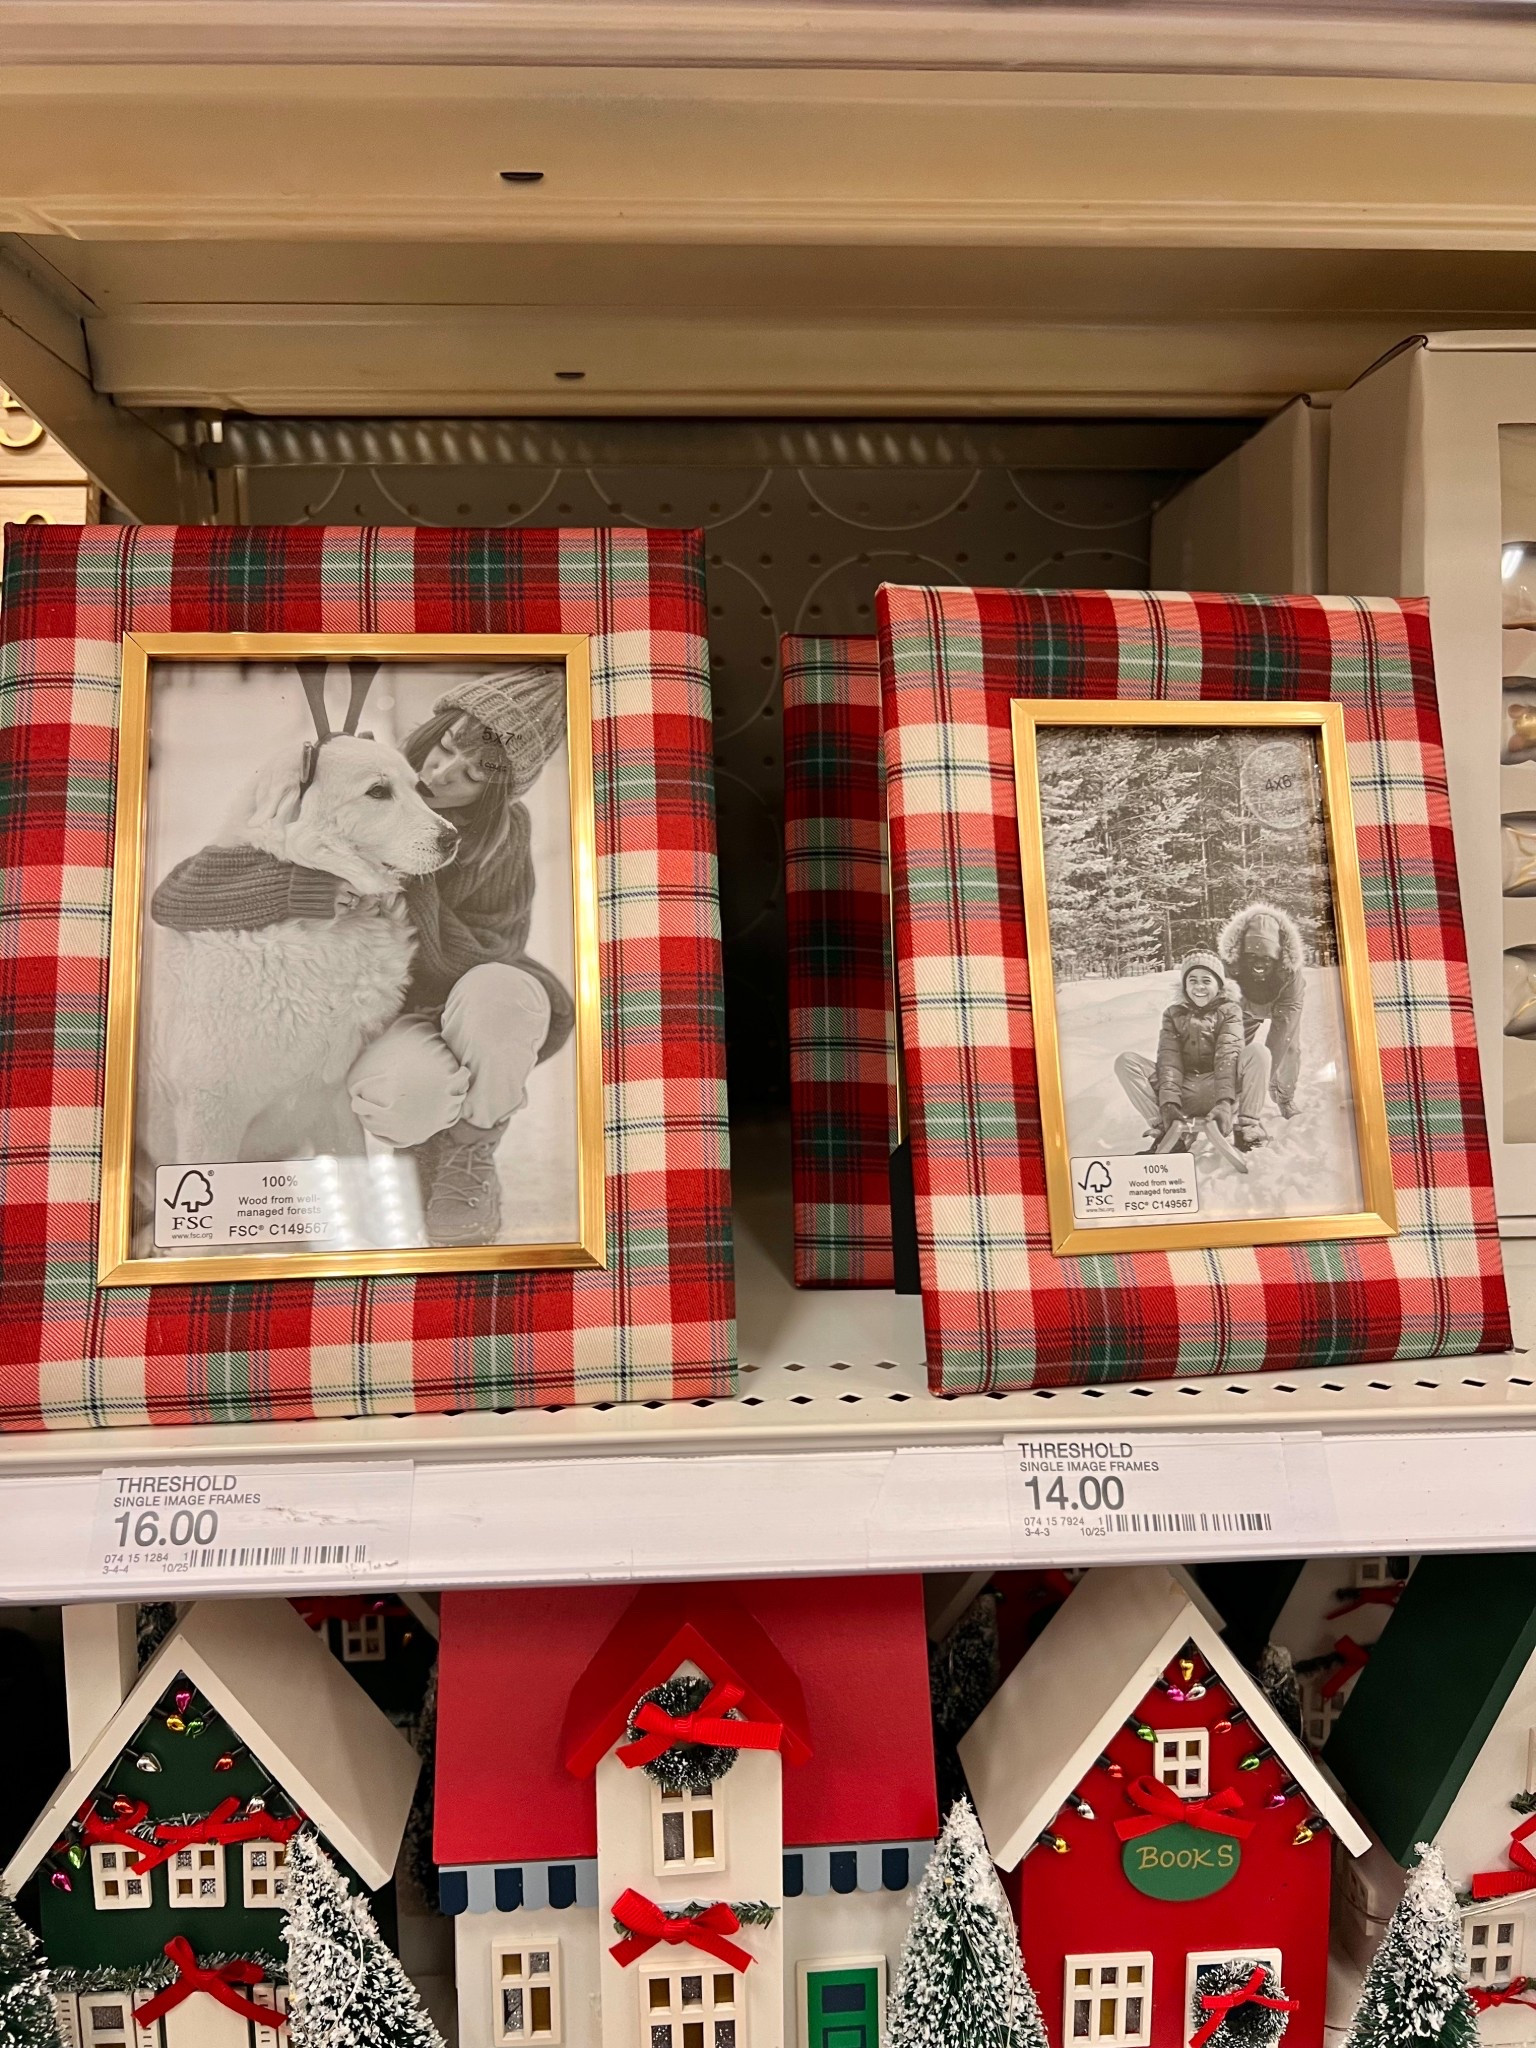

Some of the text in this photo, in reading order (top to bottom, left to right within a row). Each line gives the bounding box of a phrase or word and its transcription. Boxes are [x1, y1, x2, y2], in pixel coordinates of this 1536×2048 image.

[1143, 1164, 1169, 1174] 100%
[261, 1175, 298, 1188] 100%
[1128, 1178, 1185, 1188] Wood from well-
[1128, 1187, 1187, 1197] managed forests
[238, 1194, 321, 1206] Wood from well-
[1085, 1194, 1114, 1206] FSC
[1151, 1199, 1193, 1210] C149567
[237, 1205, 322, 1218] managed forests
[171, 1215, 213, 1231] FSC
[269, 1221, 329, 1236] C149567
[171, 1231, 213, 1240] www.fsc.org
[1018, 1442, 1133, 1459] THRESHOLD
[1019, 1461, 1159, 1473] SINGLE IMAGE FRAMES
[116, 1474, 237, 1494] THRESHOLD
[1024, 1475, 1125, 1511] 14.00
[113, 1493, 261, 1508] SINGLE IMAGE FRAMES
[1023, 1516, 1042, 1527] 074
[1046, 1516, 1058, 1527] 15
[1060, 1516, 1085, 1527] 7924
[114, 1509, 218, 1547] 16.00
[1024, 1526, 1107, 1538] 3-4-3 10/25
[104, 1553, 124, 1564] 074
[128, 1553, 140, 1563] 15
[144, 1552, 169, 1563] 1284
[102, 1562, 189, 1574] 3-4-4 10/25
[1136, 1844, 1234, 1870] BOOKS
